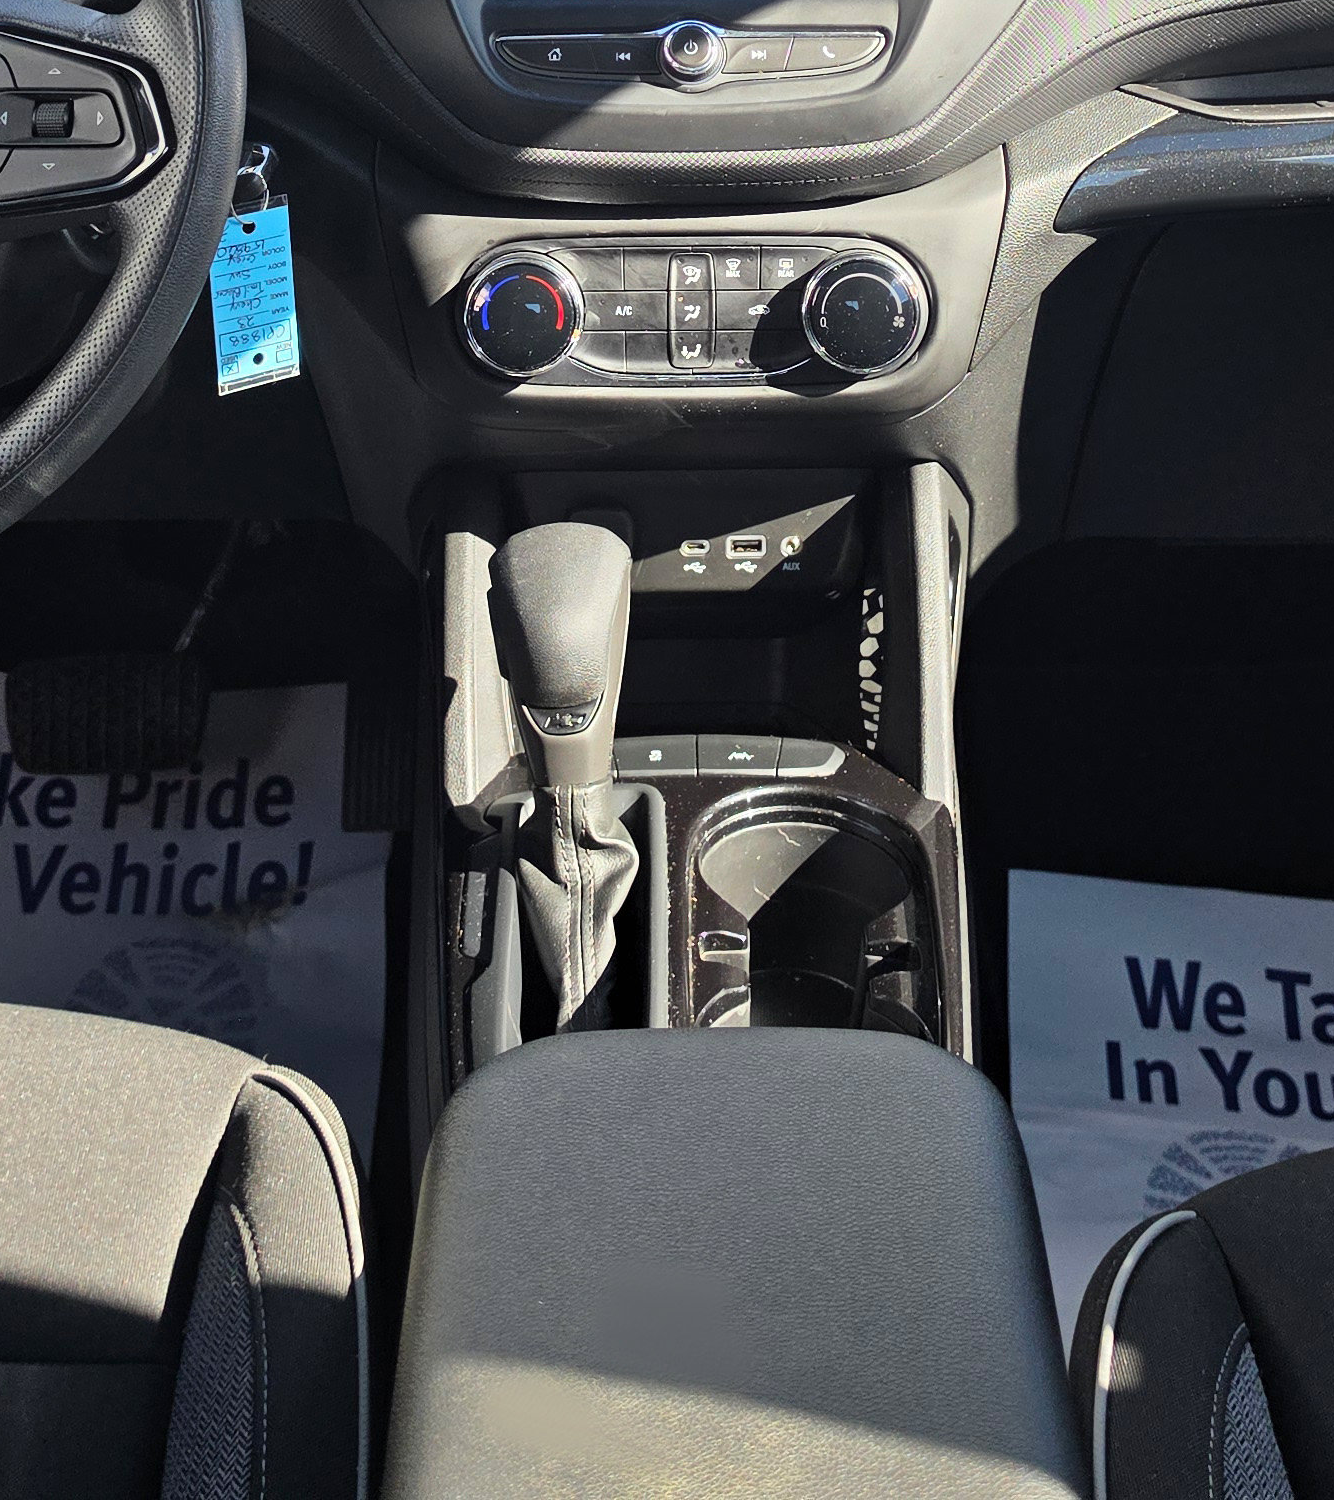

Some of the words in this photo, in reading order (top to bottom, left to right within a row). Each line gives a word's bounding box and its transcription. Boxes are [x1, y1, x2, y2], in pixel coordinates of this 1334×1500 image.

[262, 246, 286, 256] COLOR
[267, 260, 287, 271] BODY
[725, 270, 741, 278] MAX
[778, 269, 795, 278] REAR
[264, 275, 288, 286] MODEL
[269, 291, 289, 300] MAKE
[229, 292, 261, 311] Chevy
[271, 306, 290, 314] YEAR
[615, 305, 633, 316] A/C
[782, 562, 801, 572] AUX
[101, 758, 297, 831] Pride
[10, 838, 317, 919] Vehicle!
[1123, 954, 1247, 1038] We
[1104, 1040, 1180, 1106] In
